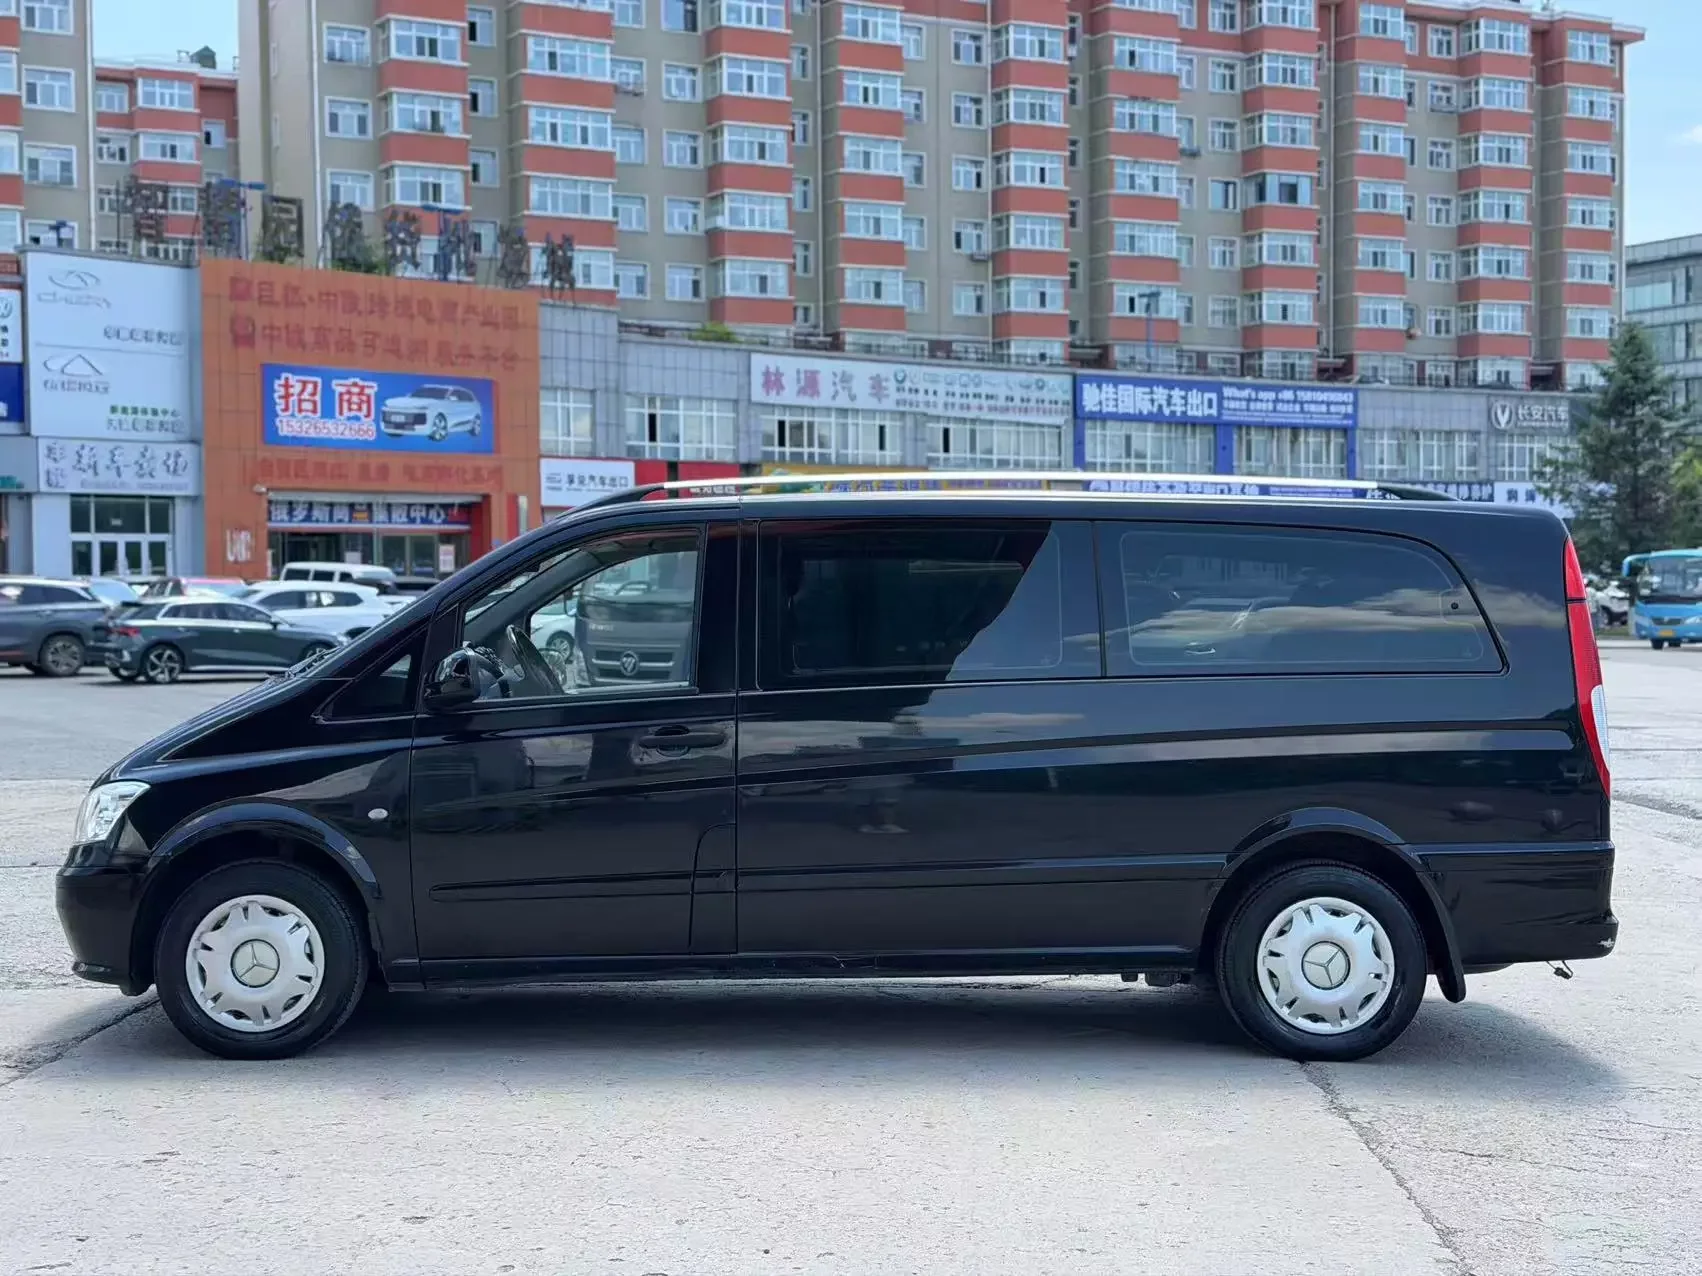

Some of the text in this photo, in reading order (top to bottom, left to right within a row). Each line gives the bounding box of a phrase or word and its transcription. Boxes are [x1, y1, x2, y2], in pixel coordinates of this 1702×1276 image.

[275, 373, 378, 420] 招商
[1518, 404, 1569, 421] 长安汽车
